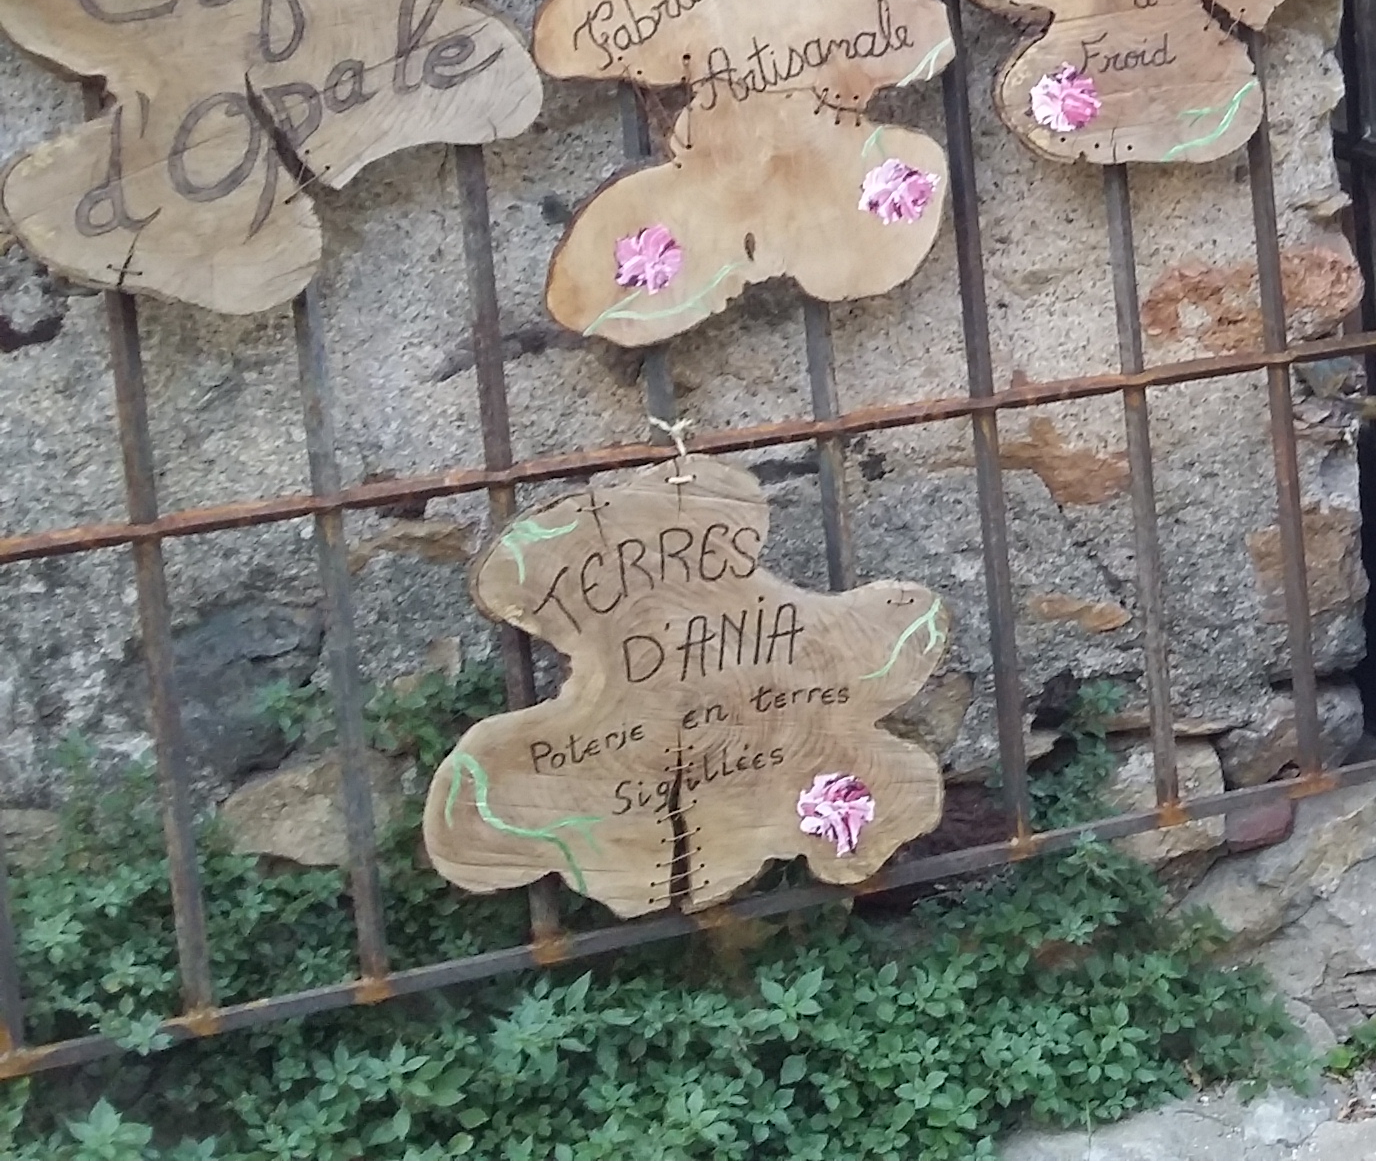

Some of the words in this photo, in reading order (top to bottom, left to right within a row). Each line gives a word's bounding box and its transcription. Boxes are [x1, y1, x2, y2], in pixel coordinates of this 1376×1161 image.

[1080, 32, 1177, 76] Froid
[533, 522, 762, 634] TERRES
[530, 721, 646, 774] Poterie
[681, 703, 729, 730] en
[748, 682, 851, 715] terres
